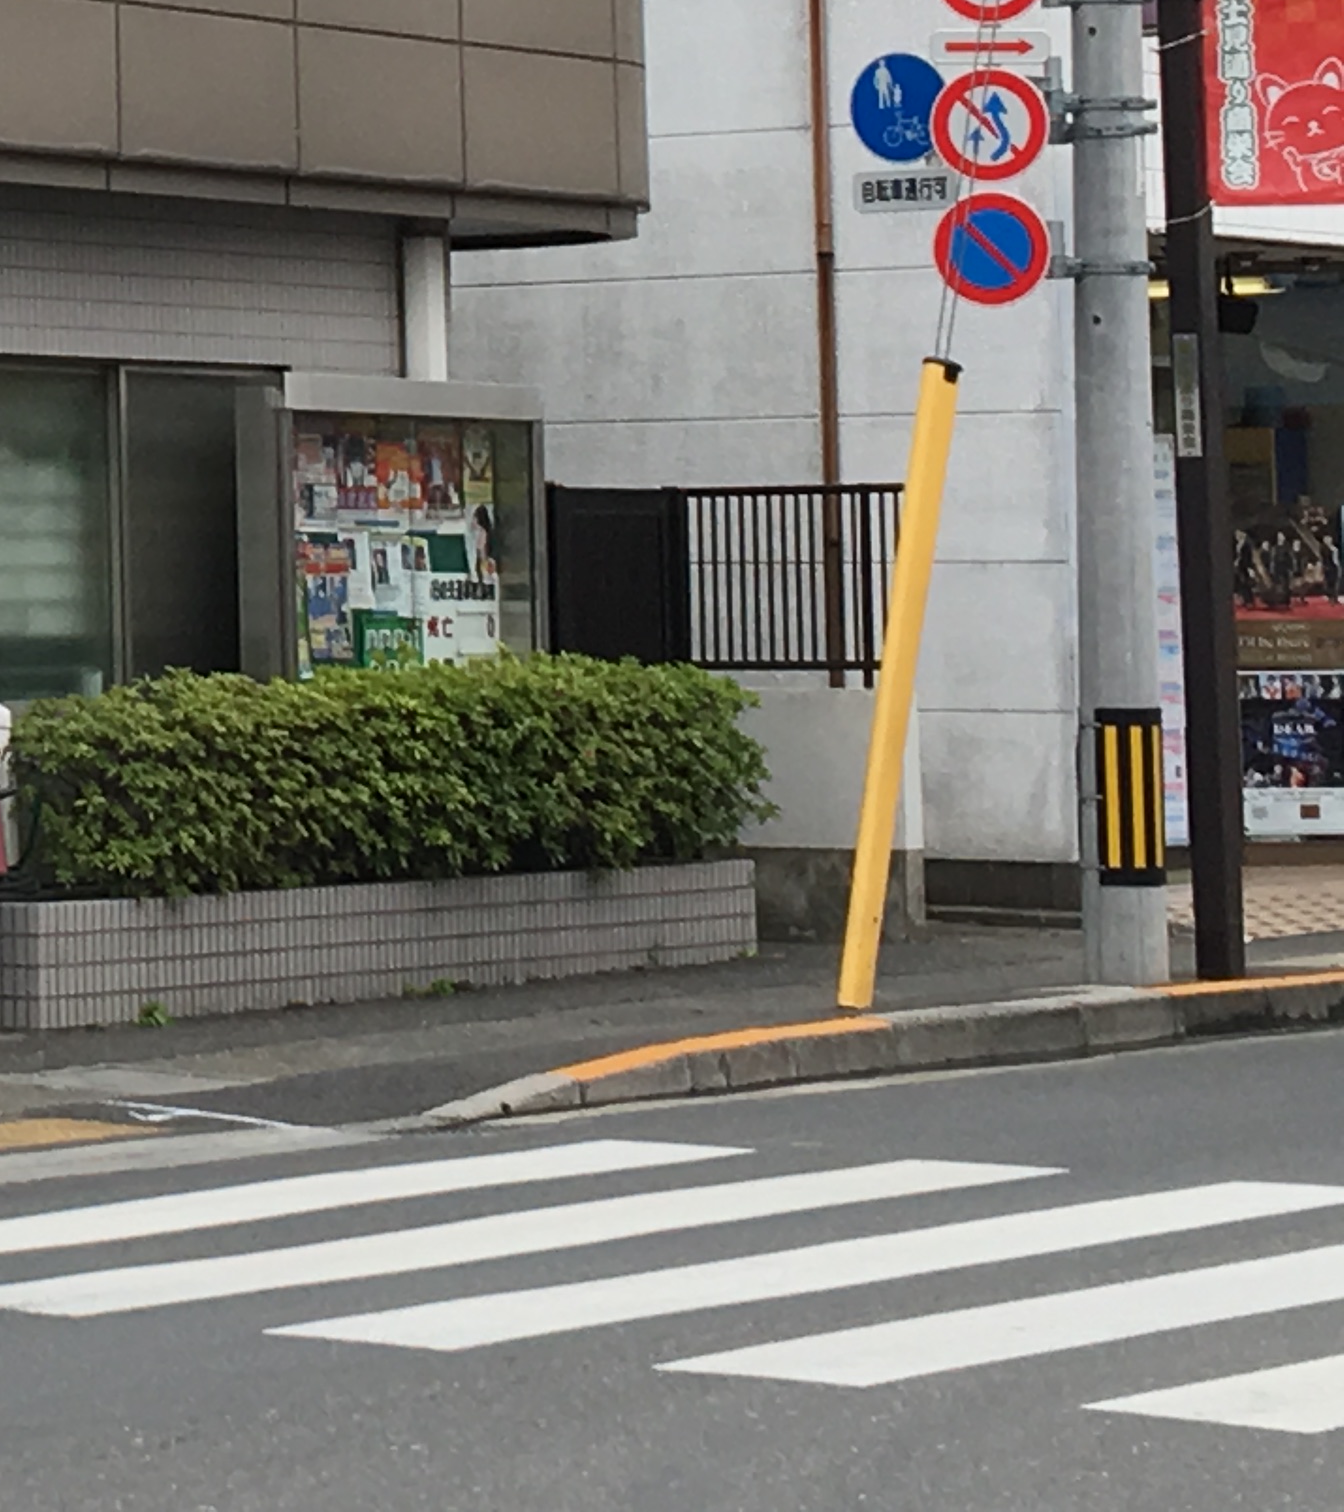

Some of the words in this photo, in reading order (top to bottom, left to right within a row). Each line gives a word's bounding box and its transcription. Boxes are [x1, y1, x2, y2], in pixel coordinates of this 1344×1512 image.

[860, 176, 948, 204] 自転車通行可
